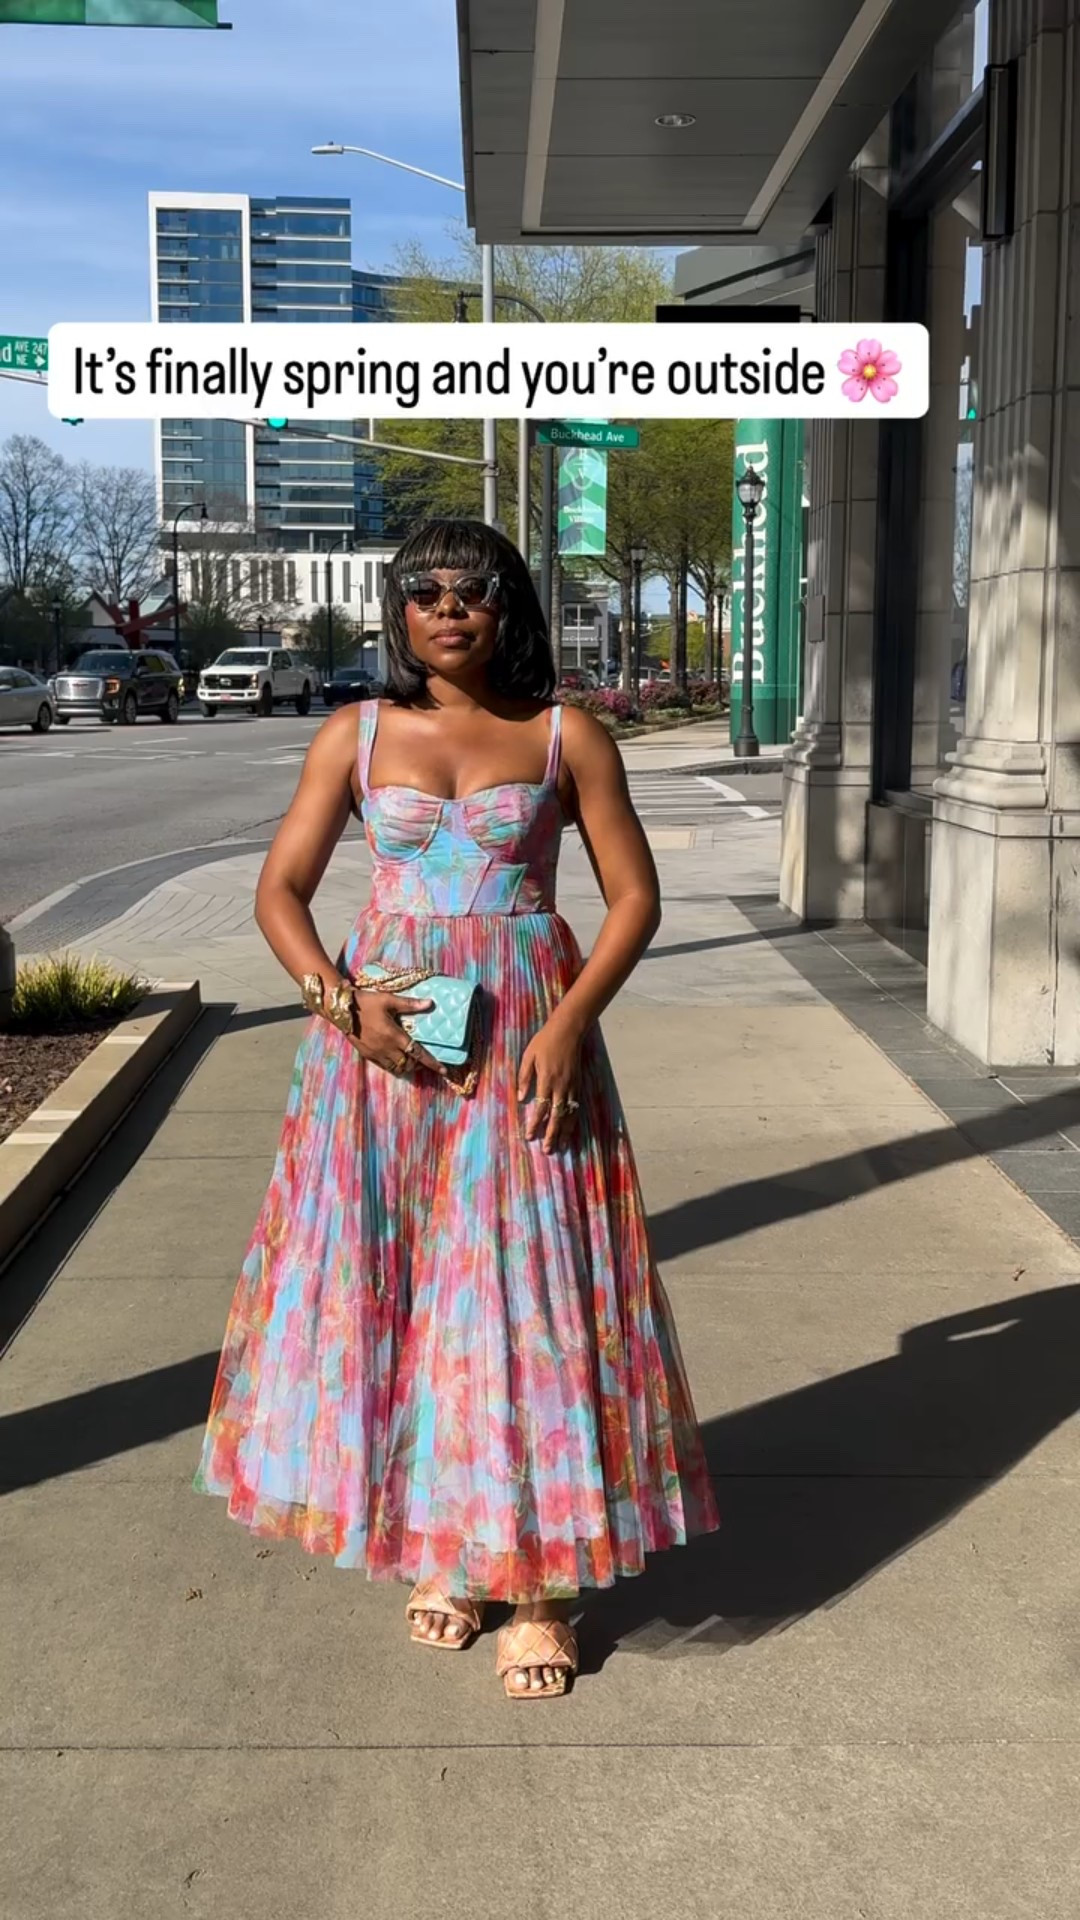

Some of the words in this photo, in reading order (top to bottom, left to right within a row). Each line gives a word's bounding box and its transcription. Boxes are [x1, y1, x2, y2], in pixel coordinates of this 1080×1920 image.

[14, 340, 30, 353] AVE
[32, 341, 48, 356] 247
[16, 353, 29, 367] NE
[550, 427, 603, 442] Buckhead
[605, 431, 625, 443] Ave
